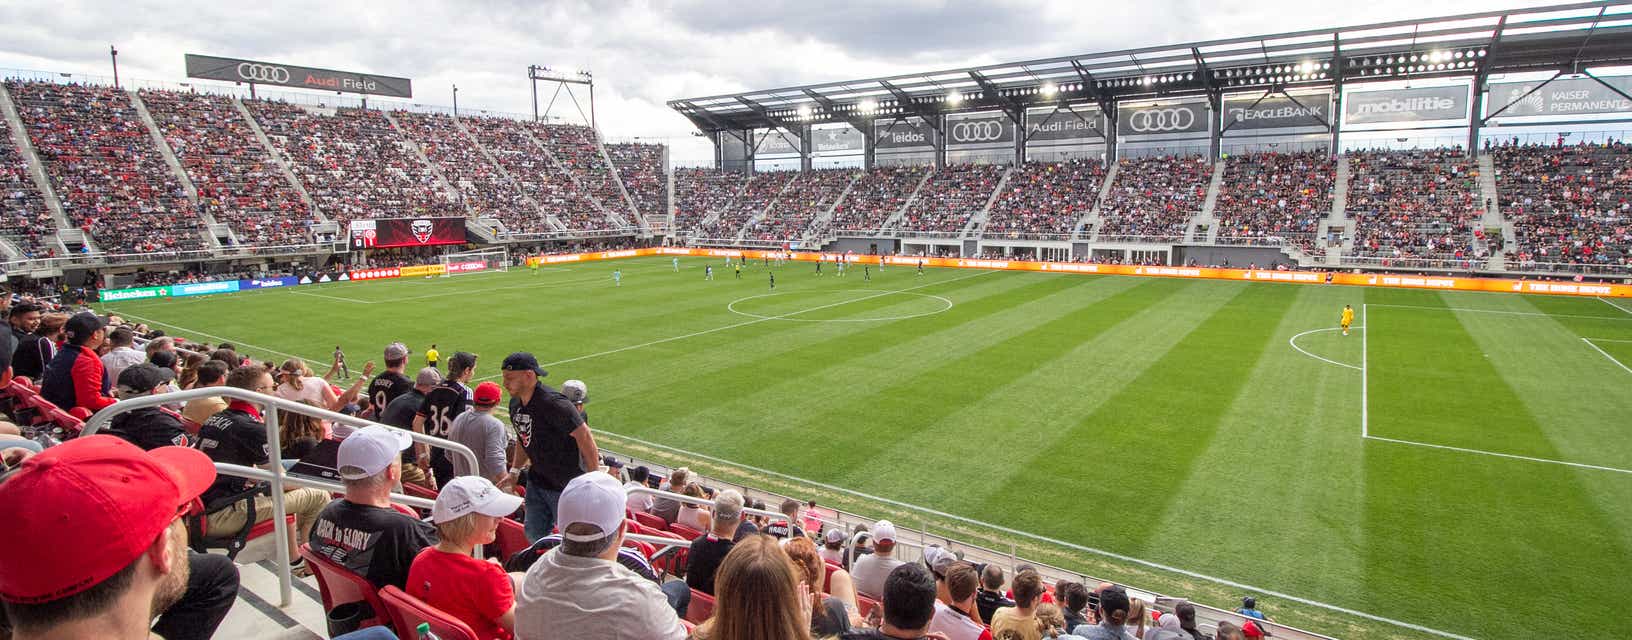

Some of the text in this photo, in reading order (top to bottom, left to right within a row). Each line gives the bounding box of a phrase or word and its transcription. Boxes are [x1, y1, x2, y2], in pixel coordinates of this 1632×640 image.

[303, 73, 376, 91] Audi Field
[1551, 90, 1590, 101] KAISER
[1356, 96, 1456, 114] mobilitie
[1032, 119, 1097, 132] Audi Field
[892, 131, 925, 144] leidos
[356, 238, 362, 247] 0
[102, 289, 156, 301] Heineken
[375, 390, 387, 417] 9
[430, 404, 453, 436] 36
[343, 527, 372, 551] GLORY
